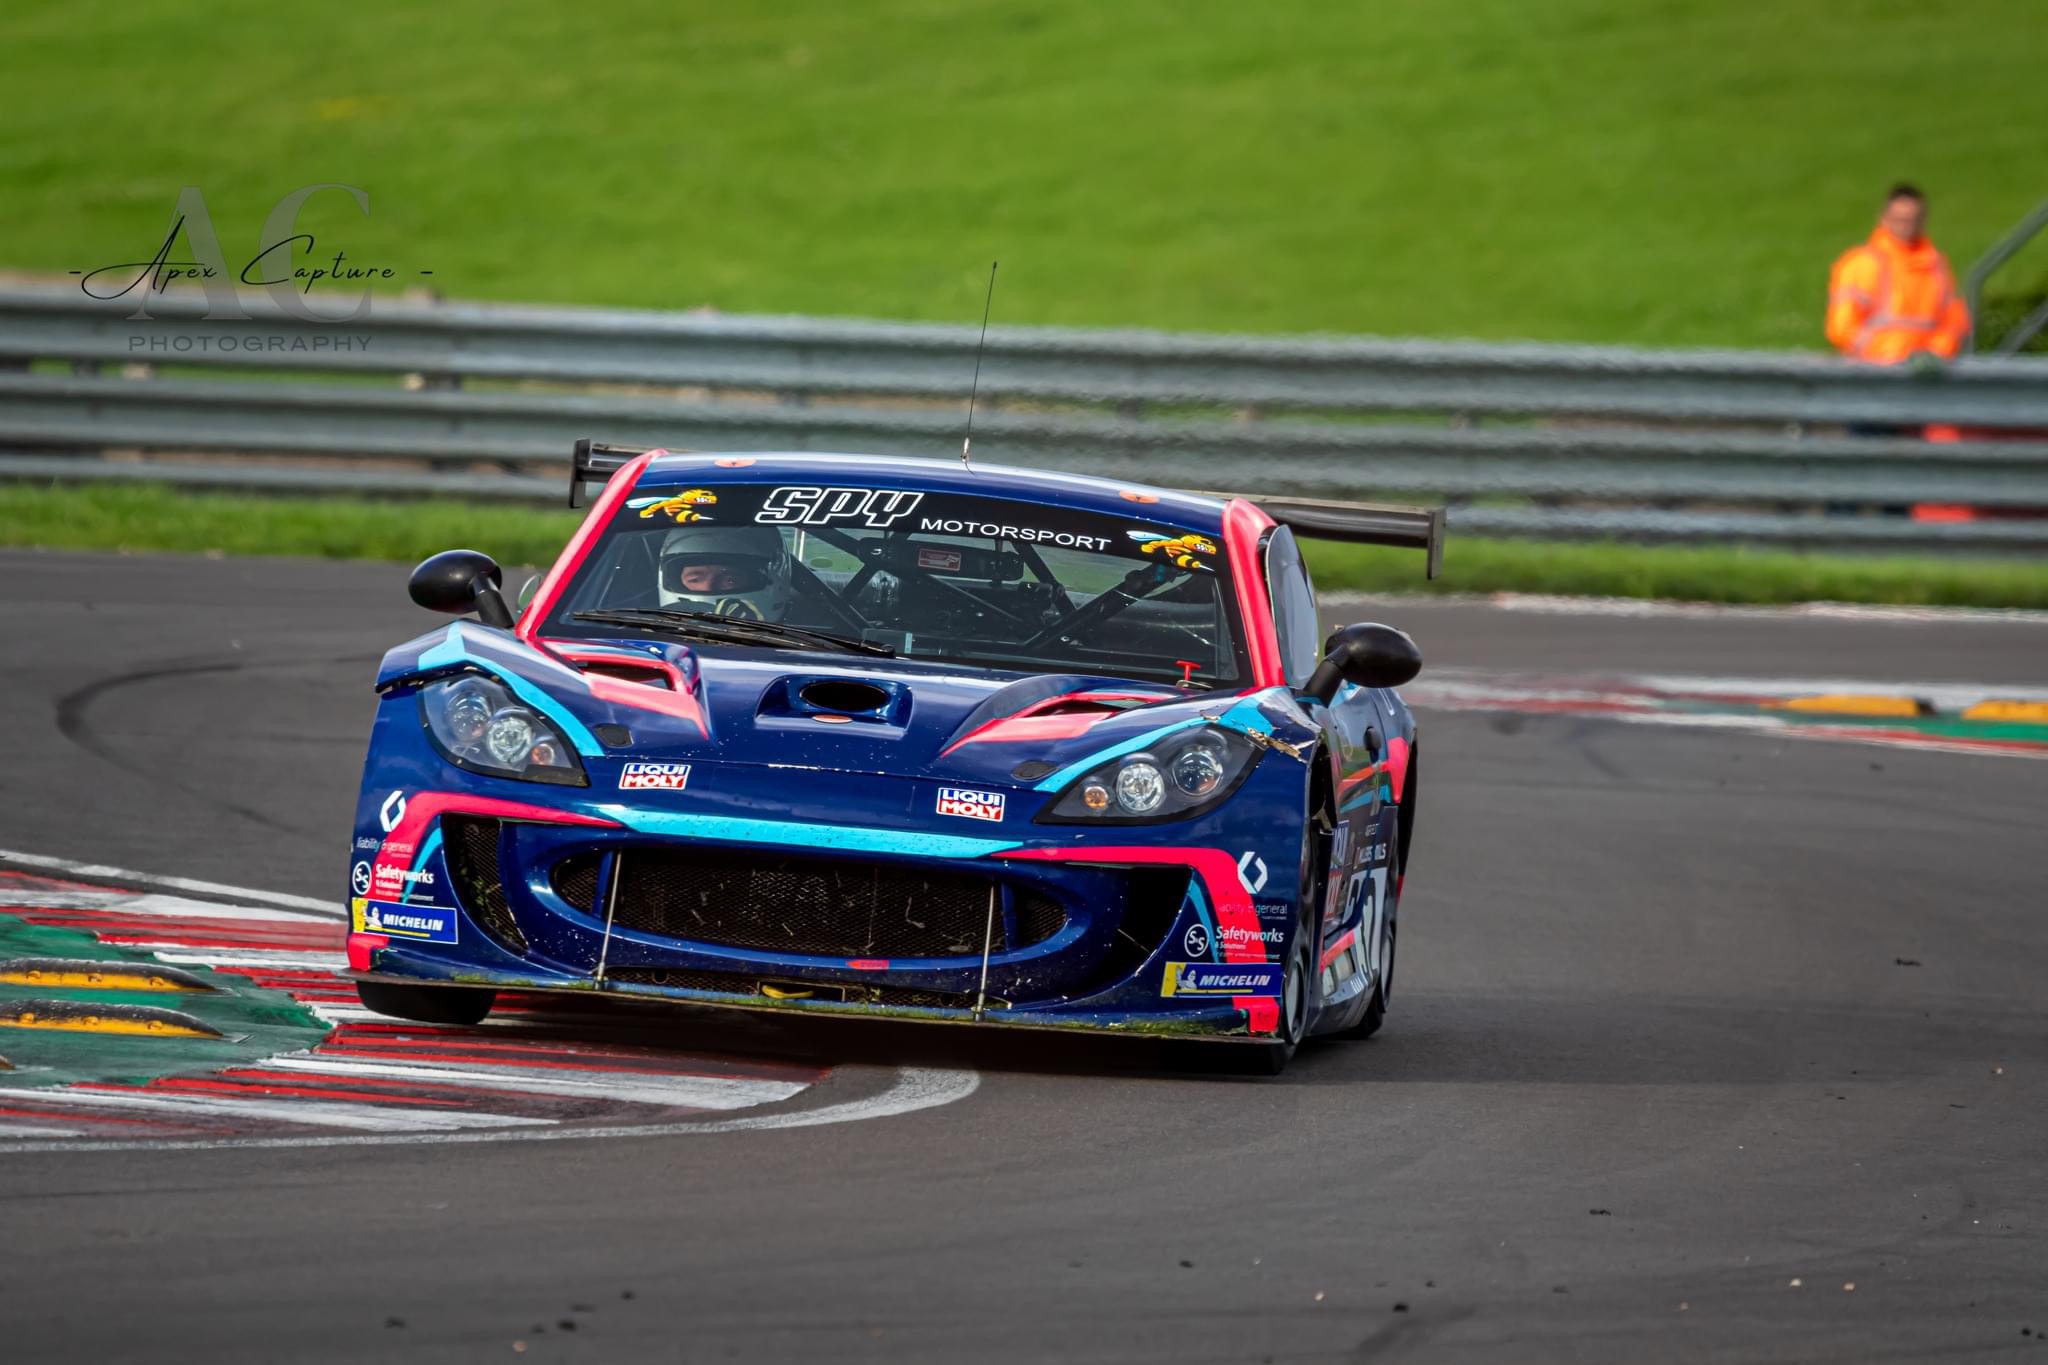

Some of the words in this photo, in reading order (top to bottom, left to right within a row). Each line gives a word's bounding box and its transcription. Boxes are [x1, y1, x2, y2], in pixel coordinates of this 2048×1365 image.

[755, 487, 923, 527] SPY
[920, 517, 1112, 552] MOTORSPORT
[627, 764, 687, 775] LIQUI
[623, 774, 686, 788] MOLY
[942, 789, 1001, 806] LIQUI
[940, 800, 1002, 819] MOLY
[1255, 904, 1288, 917] general
[383, 914, 443, 931] MICHELIN
[1215, 926, 1284, 943] Safetyworks
[1199, 974, 1272, 987] MICHELIN
